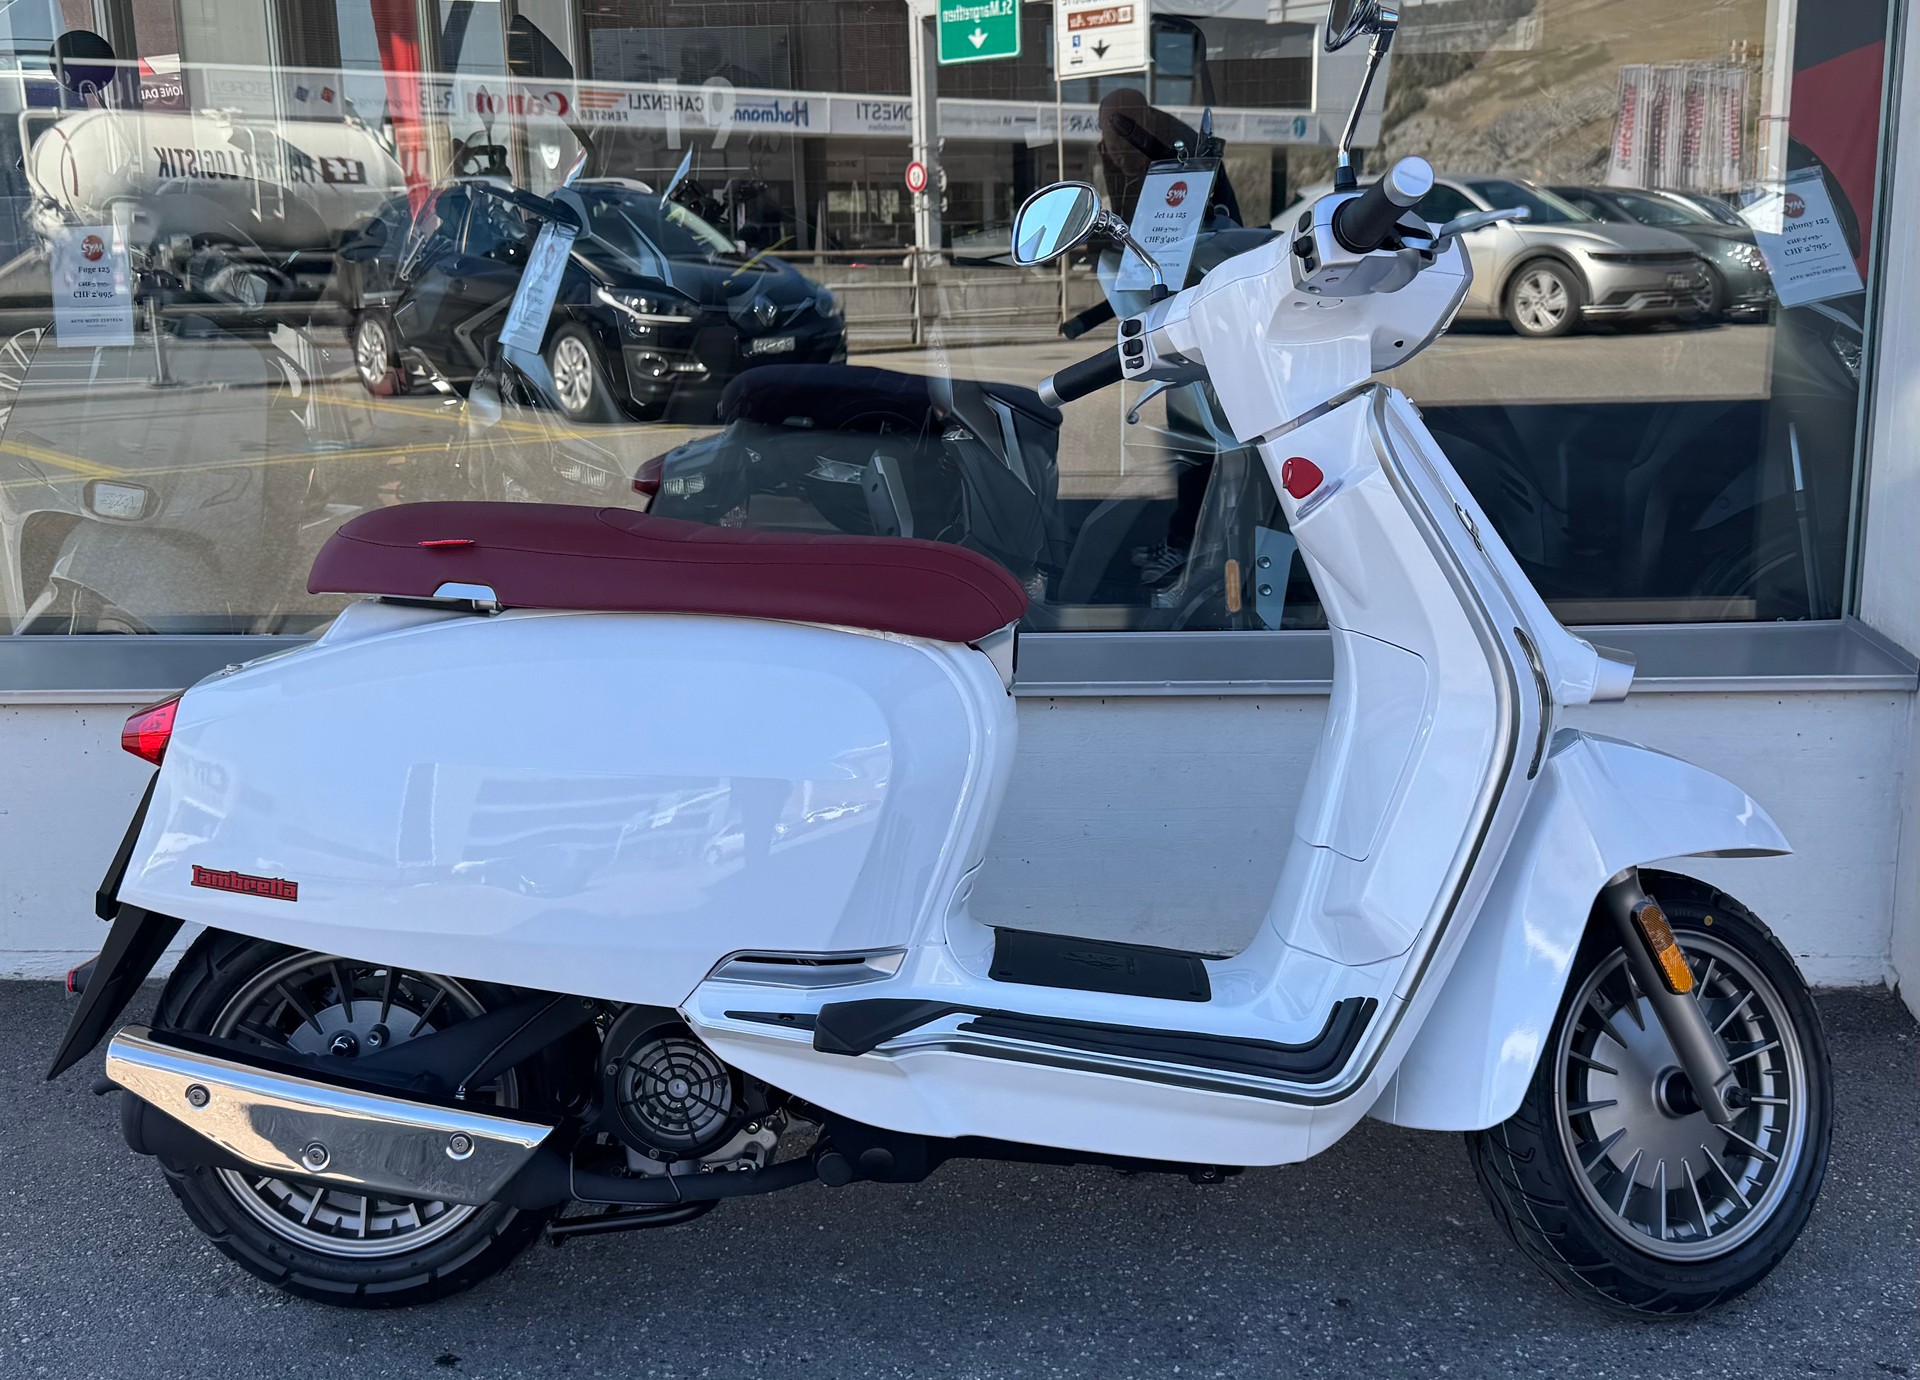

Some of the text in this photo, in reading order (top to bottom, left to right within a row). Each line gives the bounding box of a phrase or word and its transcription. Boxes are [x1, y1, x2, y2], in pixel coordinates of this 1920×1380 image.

[1165, 189, 1187, 202] SYM
[1815, 217, 1830, 225] 125
[82, 243, 104, 256] SYM
[1784, 246, 1803, 256] CHF
[191, 865, 298, 901] Lambretta
